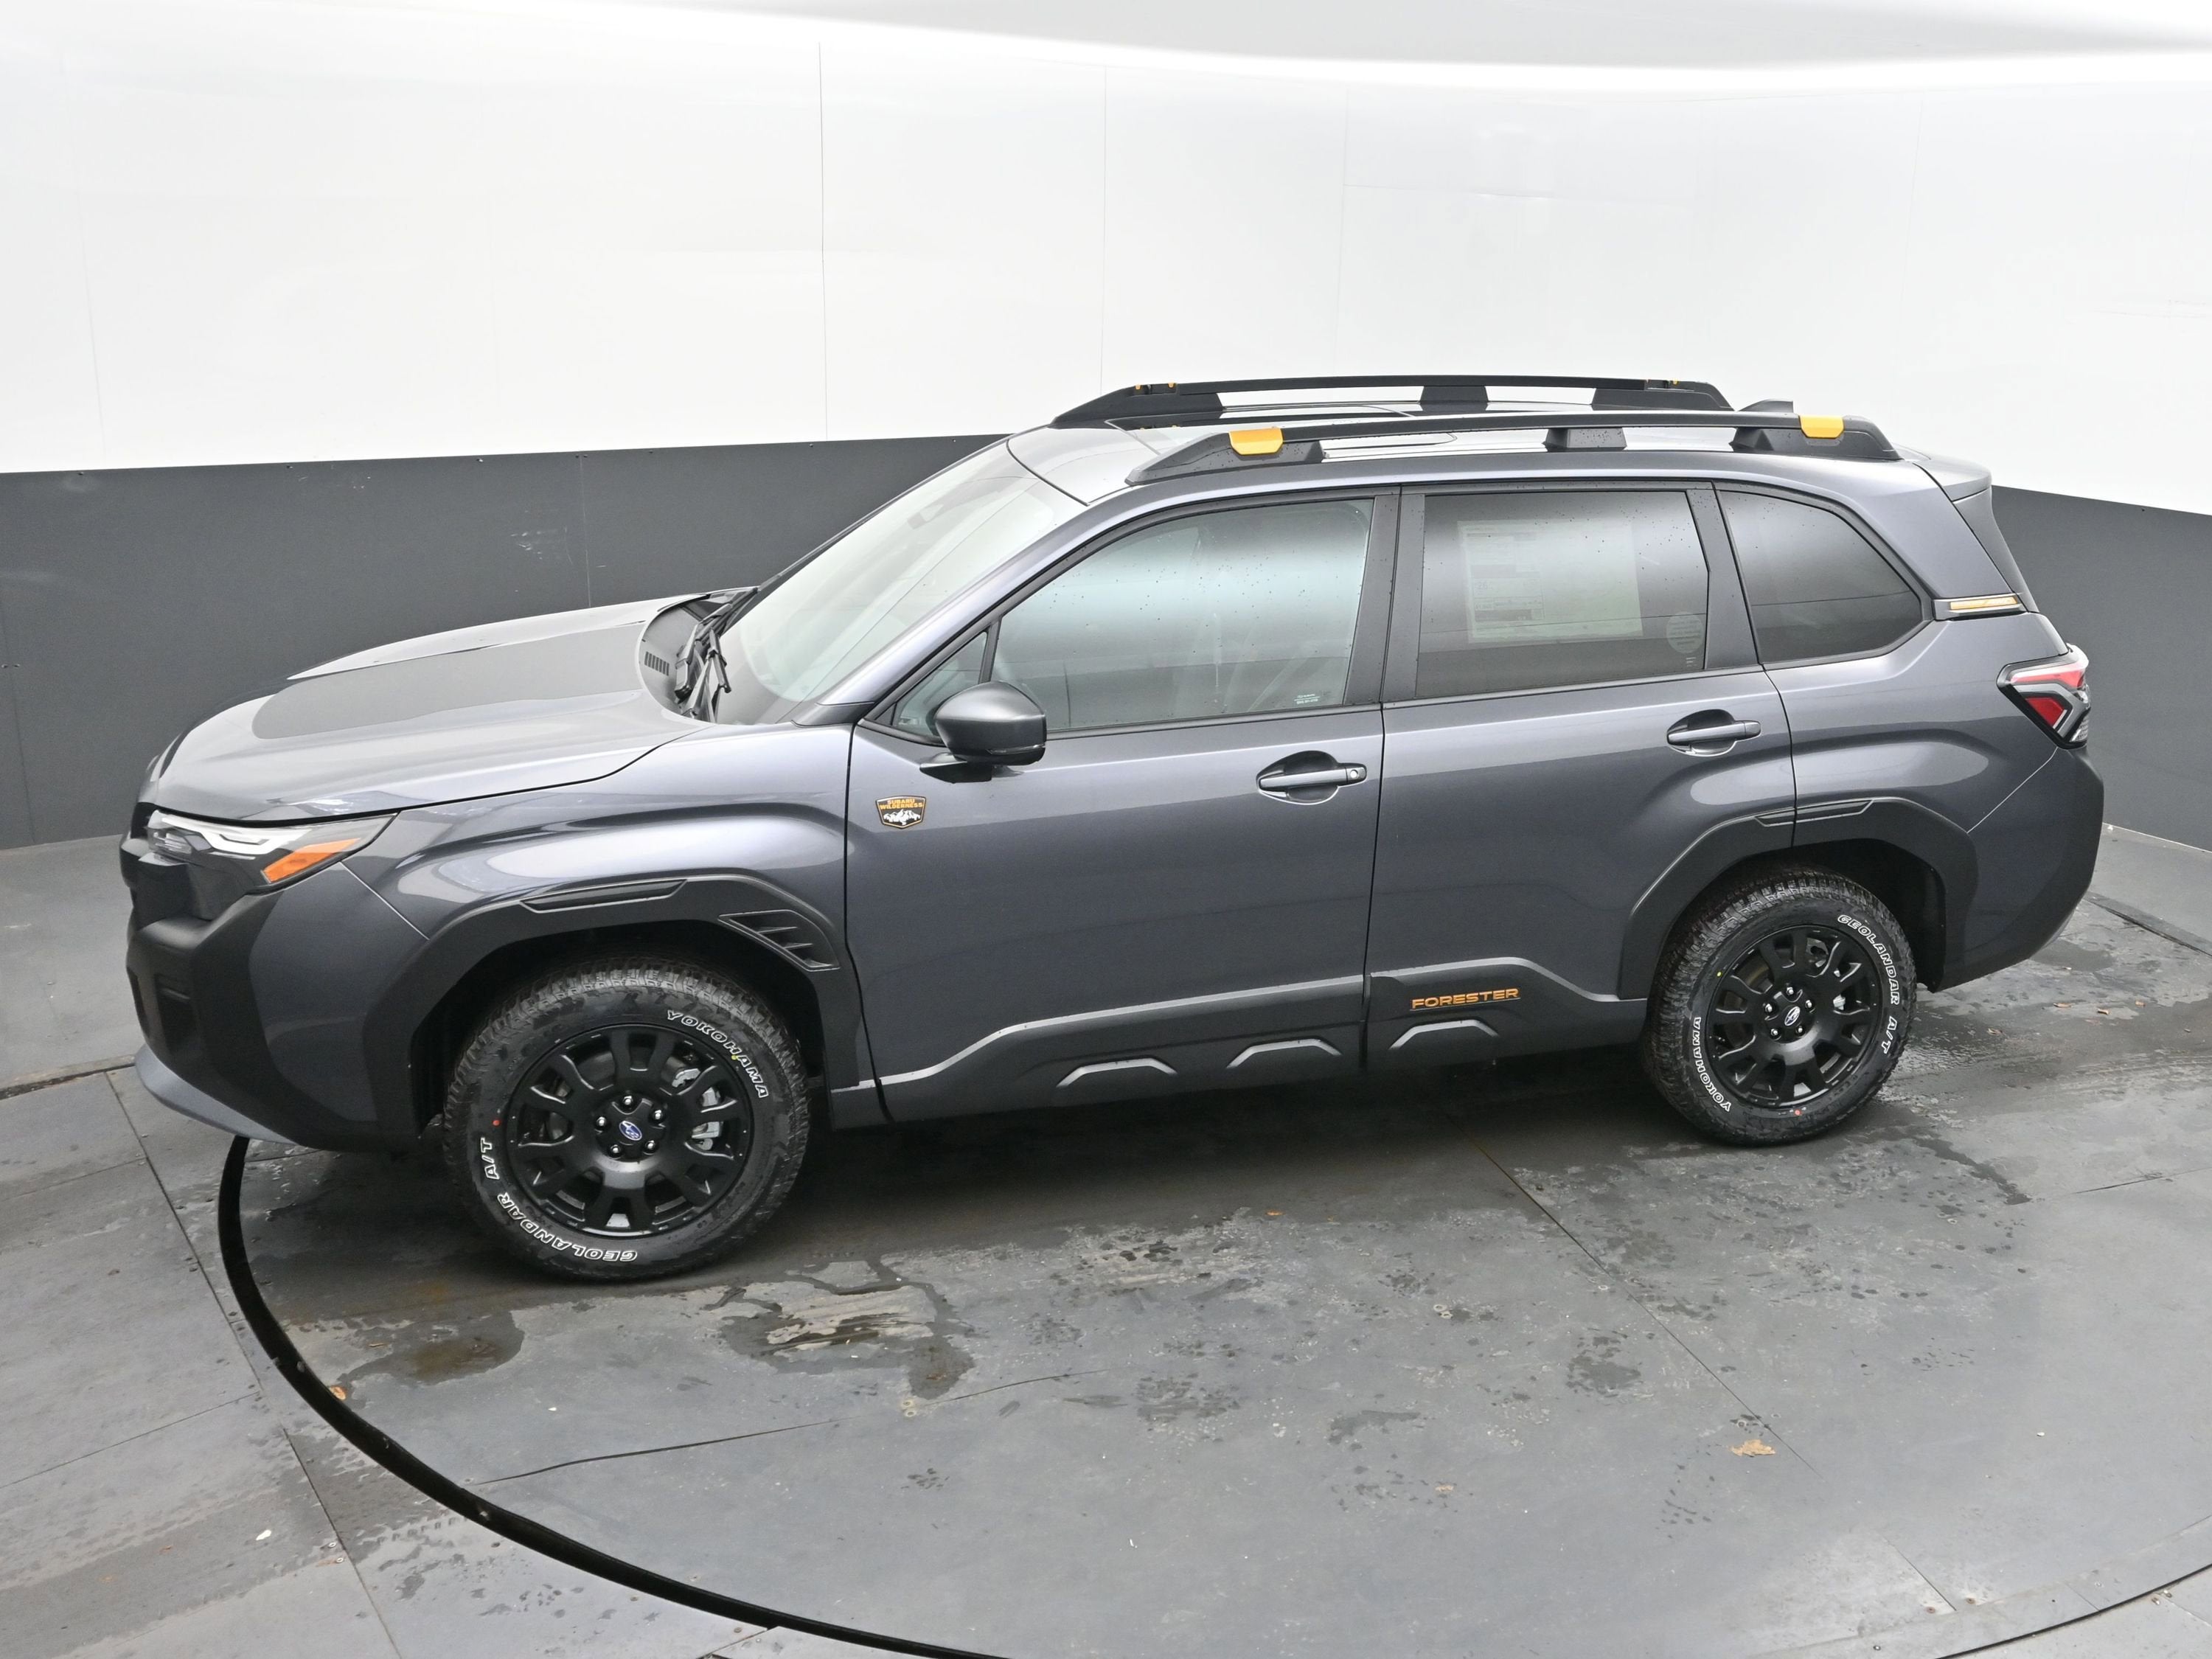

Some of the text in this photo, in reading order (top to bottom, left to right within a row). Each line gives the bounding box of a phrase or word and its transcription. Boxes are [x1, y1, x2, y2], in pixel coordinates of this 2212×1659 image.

[1411, 988, 1520, 1009] FORESTER
[1837, 914, 1899, 1054] GEOLANDAR A/T
[667, 1009, 769, 1099] YOKOHAMA
[1692, 1017, 1732, 1112] YOKOHAMA
[480, 1137, 638, 1263] GEOLANDAR A/T
